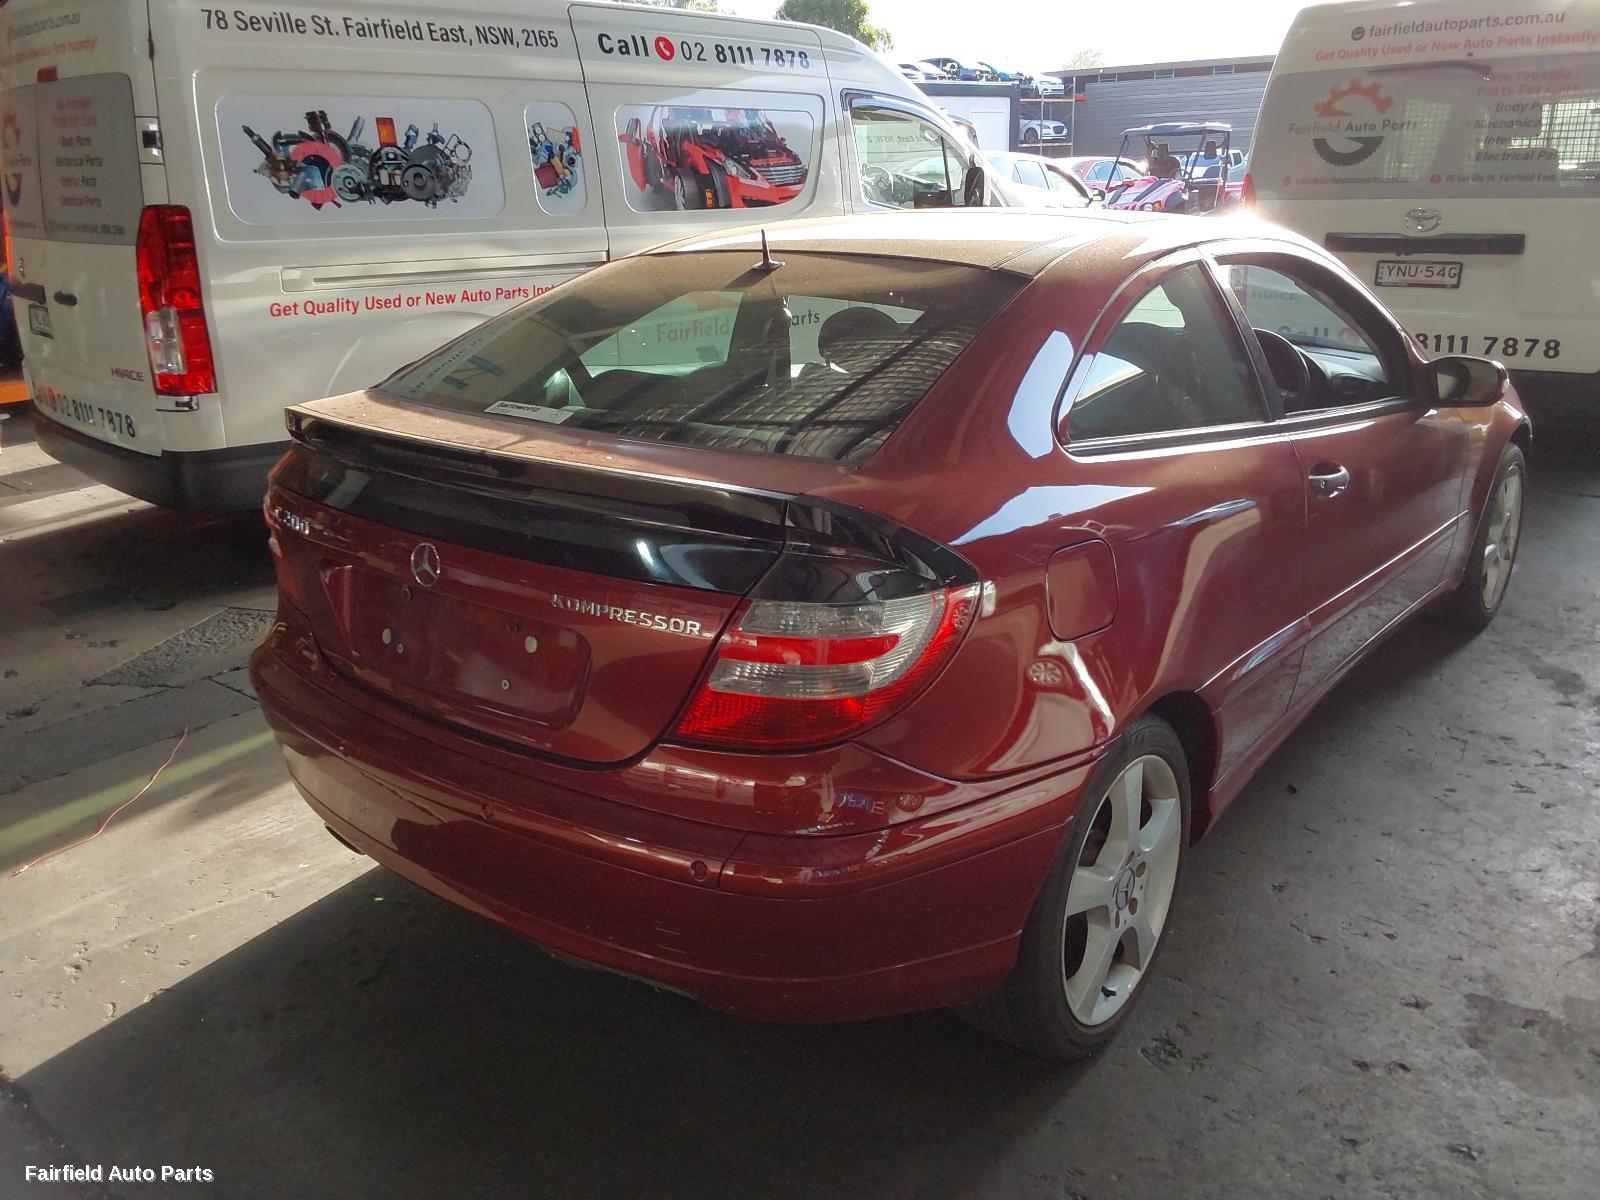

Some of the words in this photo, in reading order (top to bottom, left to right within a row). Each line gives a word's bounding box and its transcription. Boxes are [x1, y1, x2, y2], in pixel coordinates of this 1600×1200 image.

[201, 9, 228, 30] 78
[234, 10, 307, 34] Seville
[311, 15, 340, 37] St.
[345, 17, 424, 41] Fairfield
[429, 22, 473, 46] East,
[476, 25, 520, 49] NSW,
[524, 28, 559, 48] 2165
[1369, 12, 1566, 38] fairfieldautoparts.com.au
[597, 33, 649, 57] Call
[681, 41, 707, 61] 02
[715, 44, 755, 65] 8111
[760, 47, 810, 69] 7878
[1315, 50, 1335, 61] Get
[1337, 46, 1379, 60] Quality
[1382, 43, 1412, 55] Used
[1415, 44, 1428, 52] or
[1431, 40, 1459, 50] New
[1463, 38, 1493, 49] Auto
[1498, 36, 1533, 47] Parts
[1537, 31, 1600, 45] Instantly
[1288, 121, 1341, 134] Fairfield
[1344, 121, 1376, 132] Auto
[1475, 152, 1534, 162] Electrical
[270, 302, 299, 317] Get
[303, 297, 360, 316] Quality
[365, 293, 401, 310] Used
[406, 294, 421, 307] or
[426, 291, 456, 305] New
[461, 288, 491, 303] Auto
[495, 286, 529, 300] Parts
[656, 316, 730, 342] Fairfield
[792, 309, 820, 326] arts
[1483, 336, 1561, 359] 7878
[110, 366, 145, 382] HIACE
[98, 406, 136, 438] 7878
[551, 593, 702, 636] KOMPRESSOR
